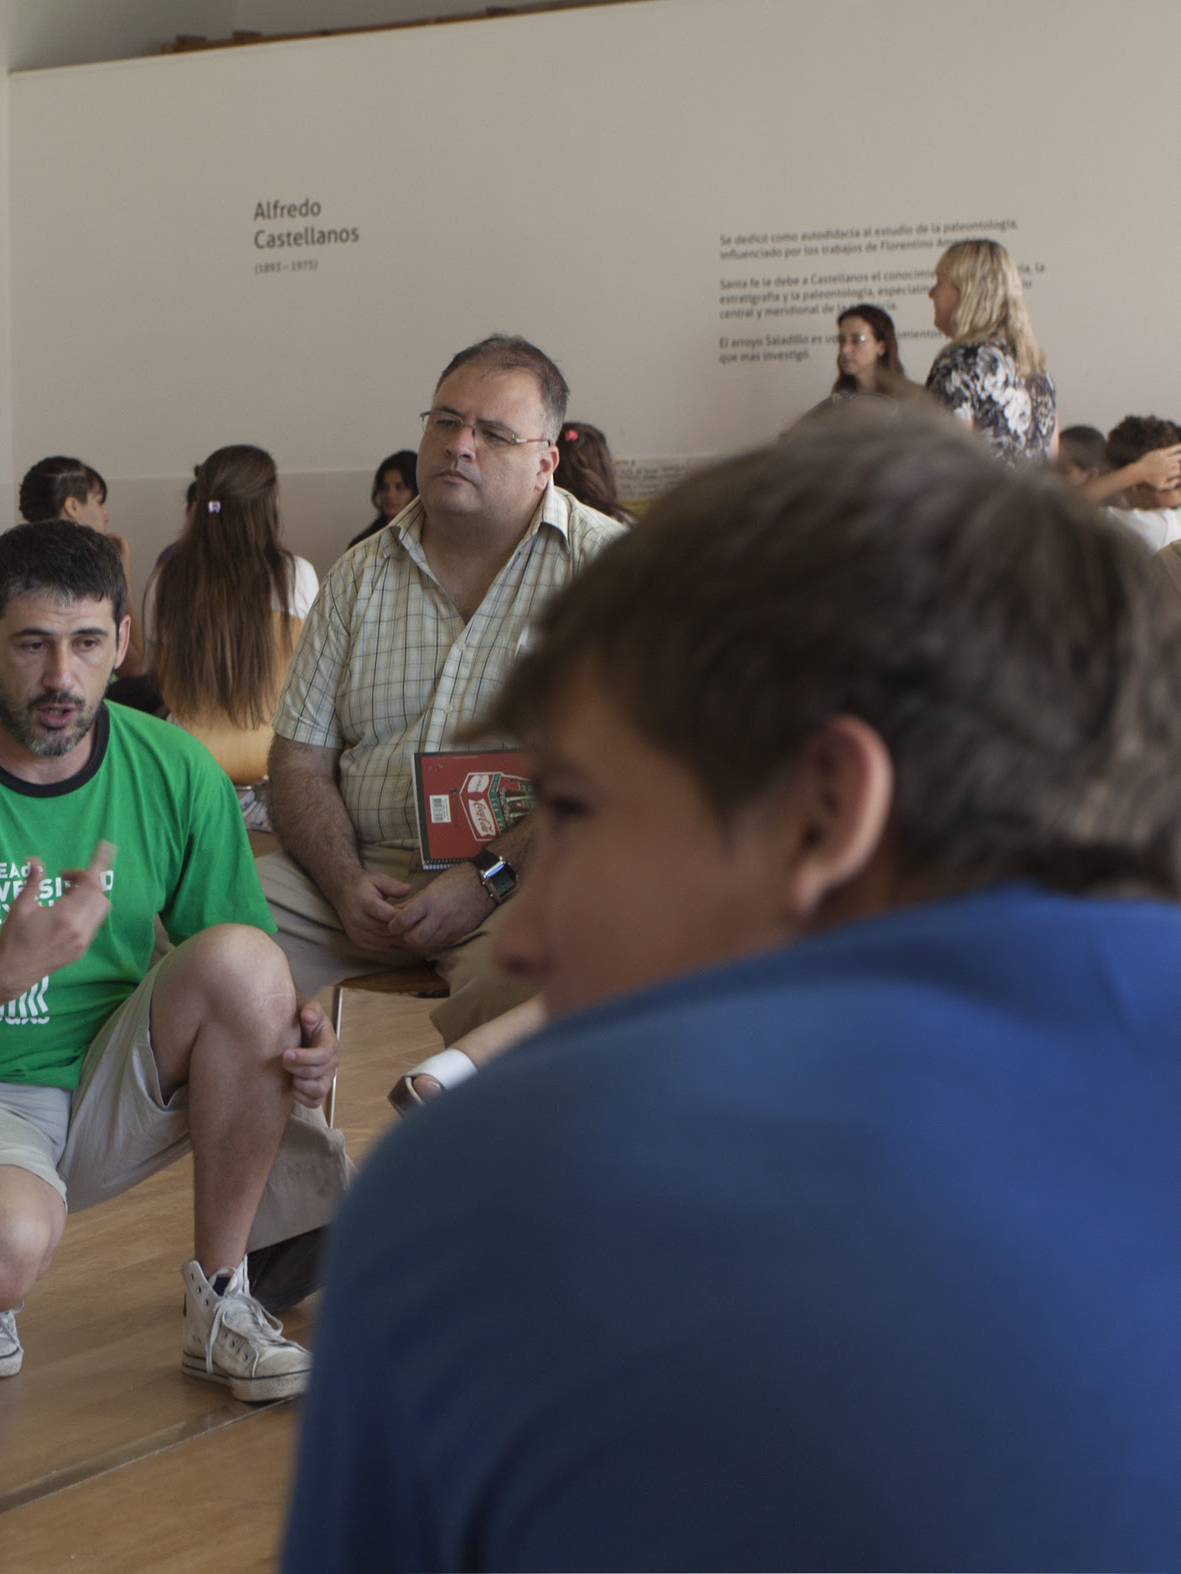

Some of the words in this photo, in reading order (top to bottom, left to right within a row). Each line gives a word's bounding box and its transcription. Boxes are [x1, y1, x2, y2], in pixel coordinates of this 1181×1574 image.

[254, 198, 322, 221] Alfredo
[253, 227, 360, 250] Castellanos
[720, 235, 732, 245] Se
[770, 233, 798, 242] como
[801, 228, 861, 241] autodidacta
[863, 227, 873, 237] al
[875, 225, 913, 236] estudio
[915, 224, 928, 234] de
[930, 223, 941, 233] la
[720, 247, 782, 260] influenciado
[784, 248, 801, 259] por
[803, 245, 819, 255] los
[821, 243, 863, 255] trabajos
[865, 241, 877, 251] de
[880, 239, 934, 250] Florentino
[720, 279, 747, 290] Santa
[762, 277, 773, 287] le
[774, 276, 800, 287] debe
[810, 273, 869, 285] Castellanos
[871, 271, 881, 282] el
[782, 294, 789, 304] y
[791, 291, 801, 301] la
[719, 307, 753, 319] central
[756, 309, 763, 320] y
[764, 304, 819, 317] meridional
[821, 303, 834, 313] de
[719, 337, 729, 348] El
[731, 338, 763, 349] arroyo
[811, 335, 823, 343] es
[720, 354, 737, 364] que
